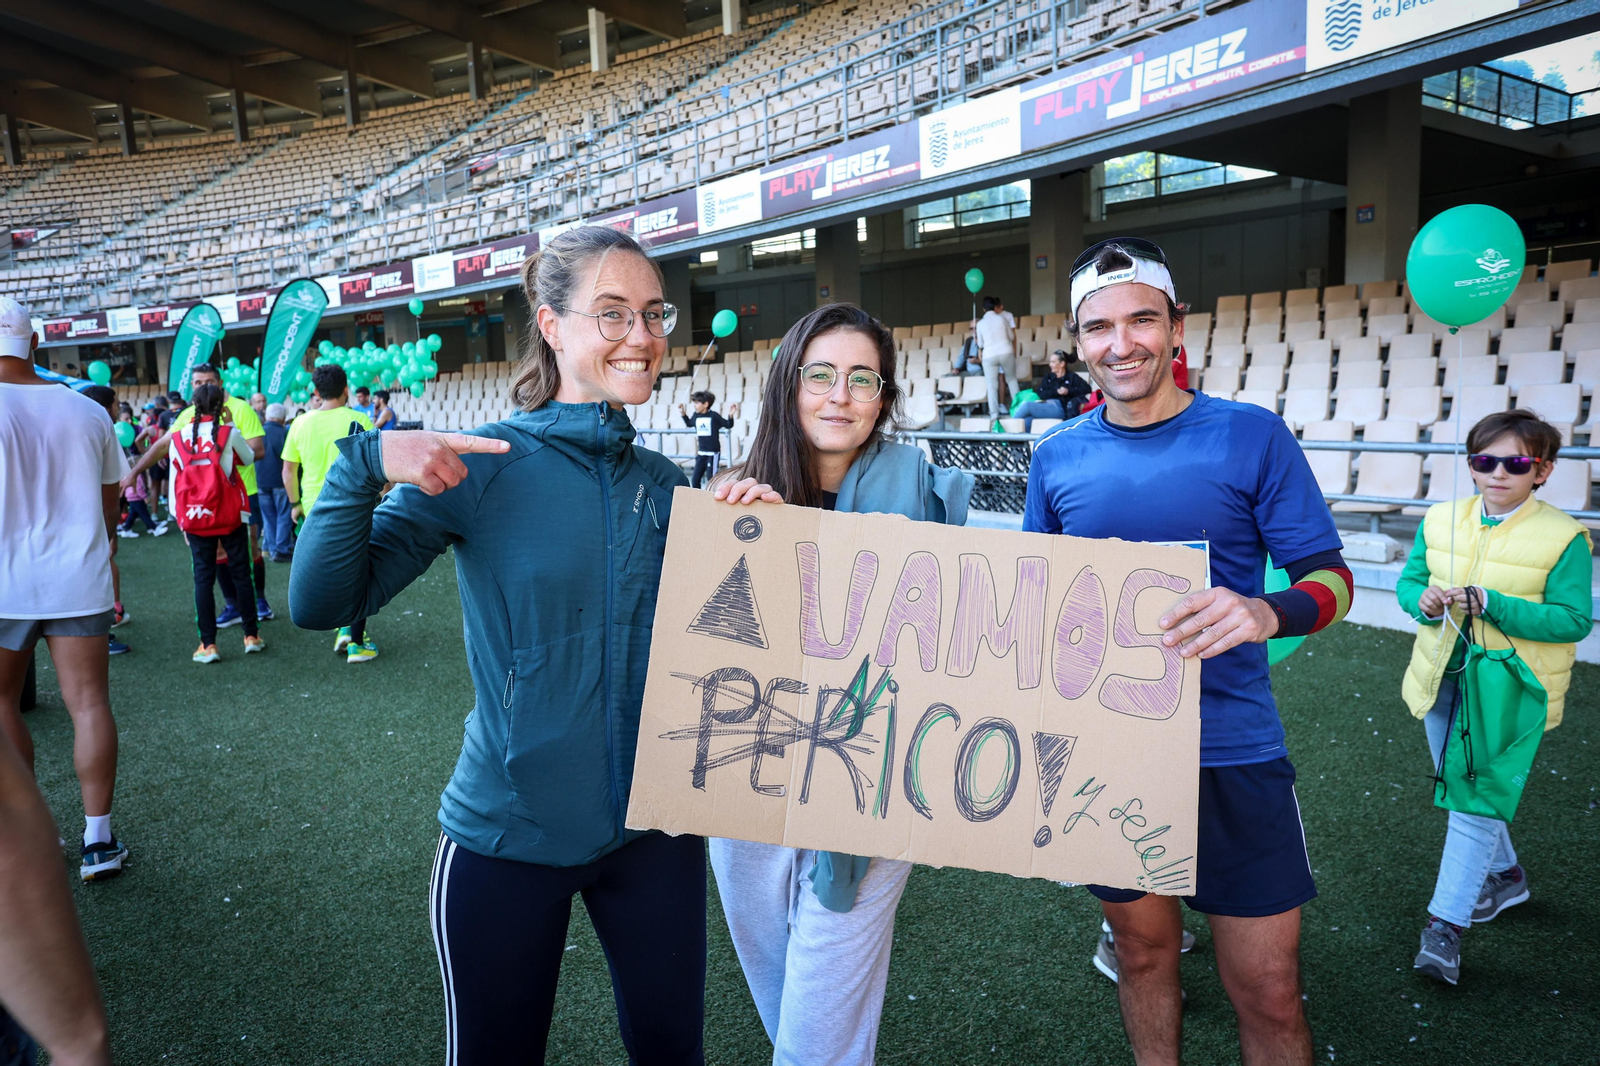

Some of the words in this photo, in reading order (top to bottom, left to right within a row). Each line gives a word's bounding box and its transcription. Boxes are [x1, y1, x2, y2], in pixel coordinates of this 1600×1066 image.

[1372, 5, 1391, 20] de
[1034, 70, 1122, 125] PLAY
[1106, 27, 1248, 120] JEREZ
[953, 117, 1010, 139] Ayuntamiento
[953, 141, 962, 150] de
[964, 136, 984, 150] Jerez
[769, 166, 821, 200] PLAY
[457, 254, 489, 274] PLAY
[343, 278, 370, 295] PLAY
[267, 311, 303, 396] ESPROHIDENT
